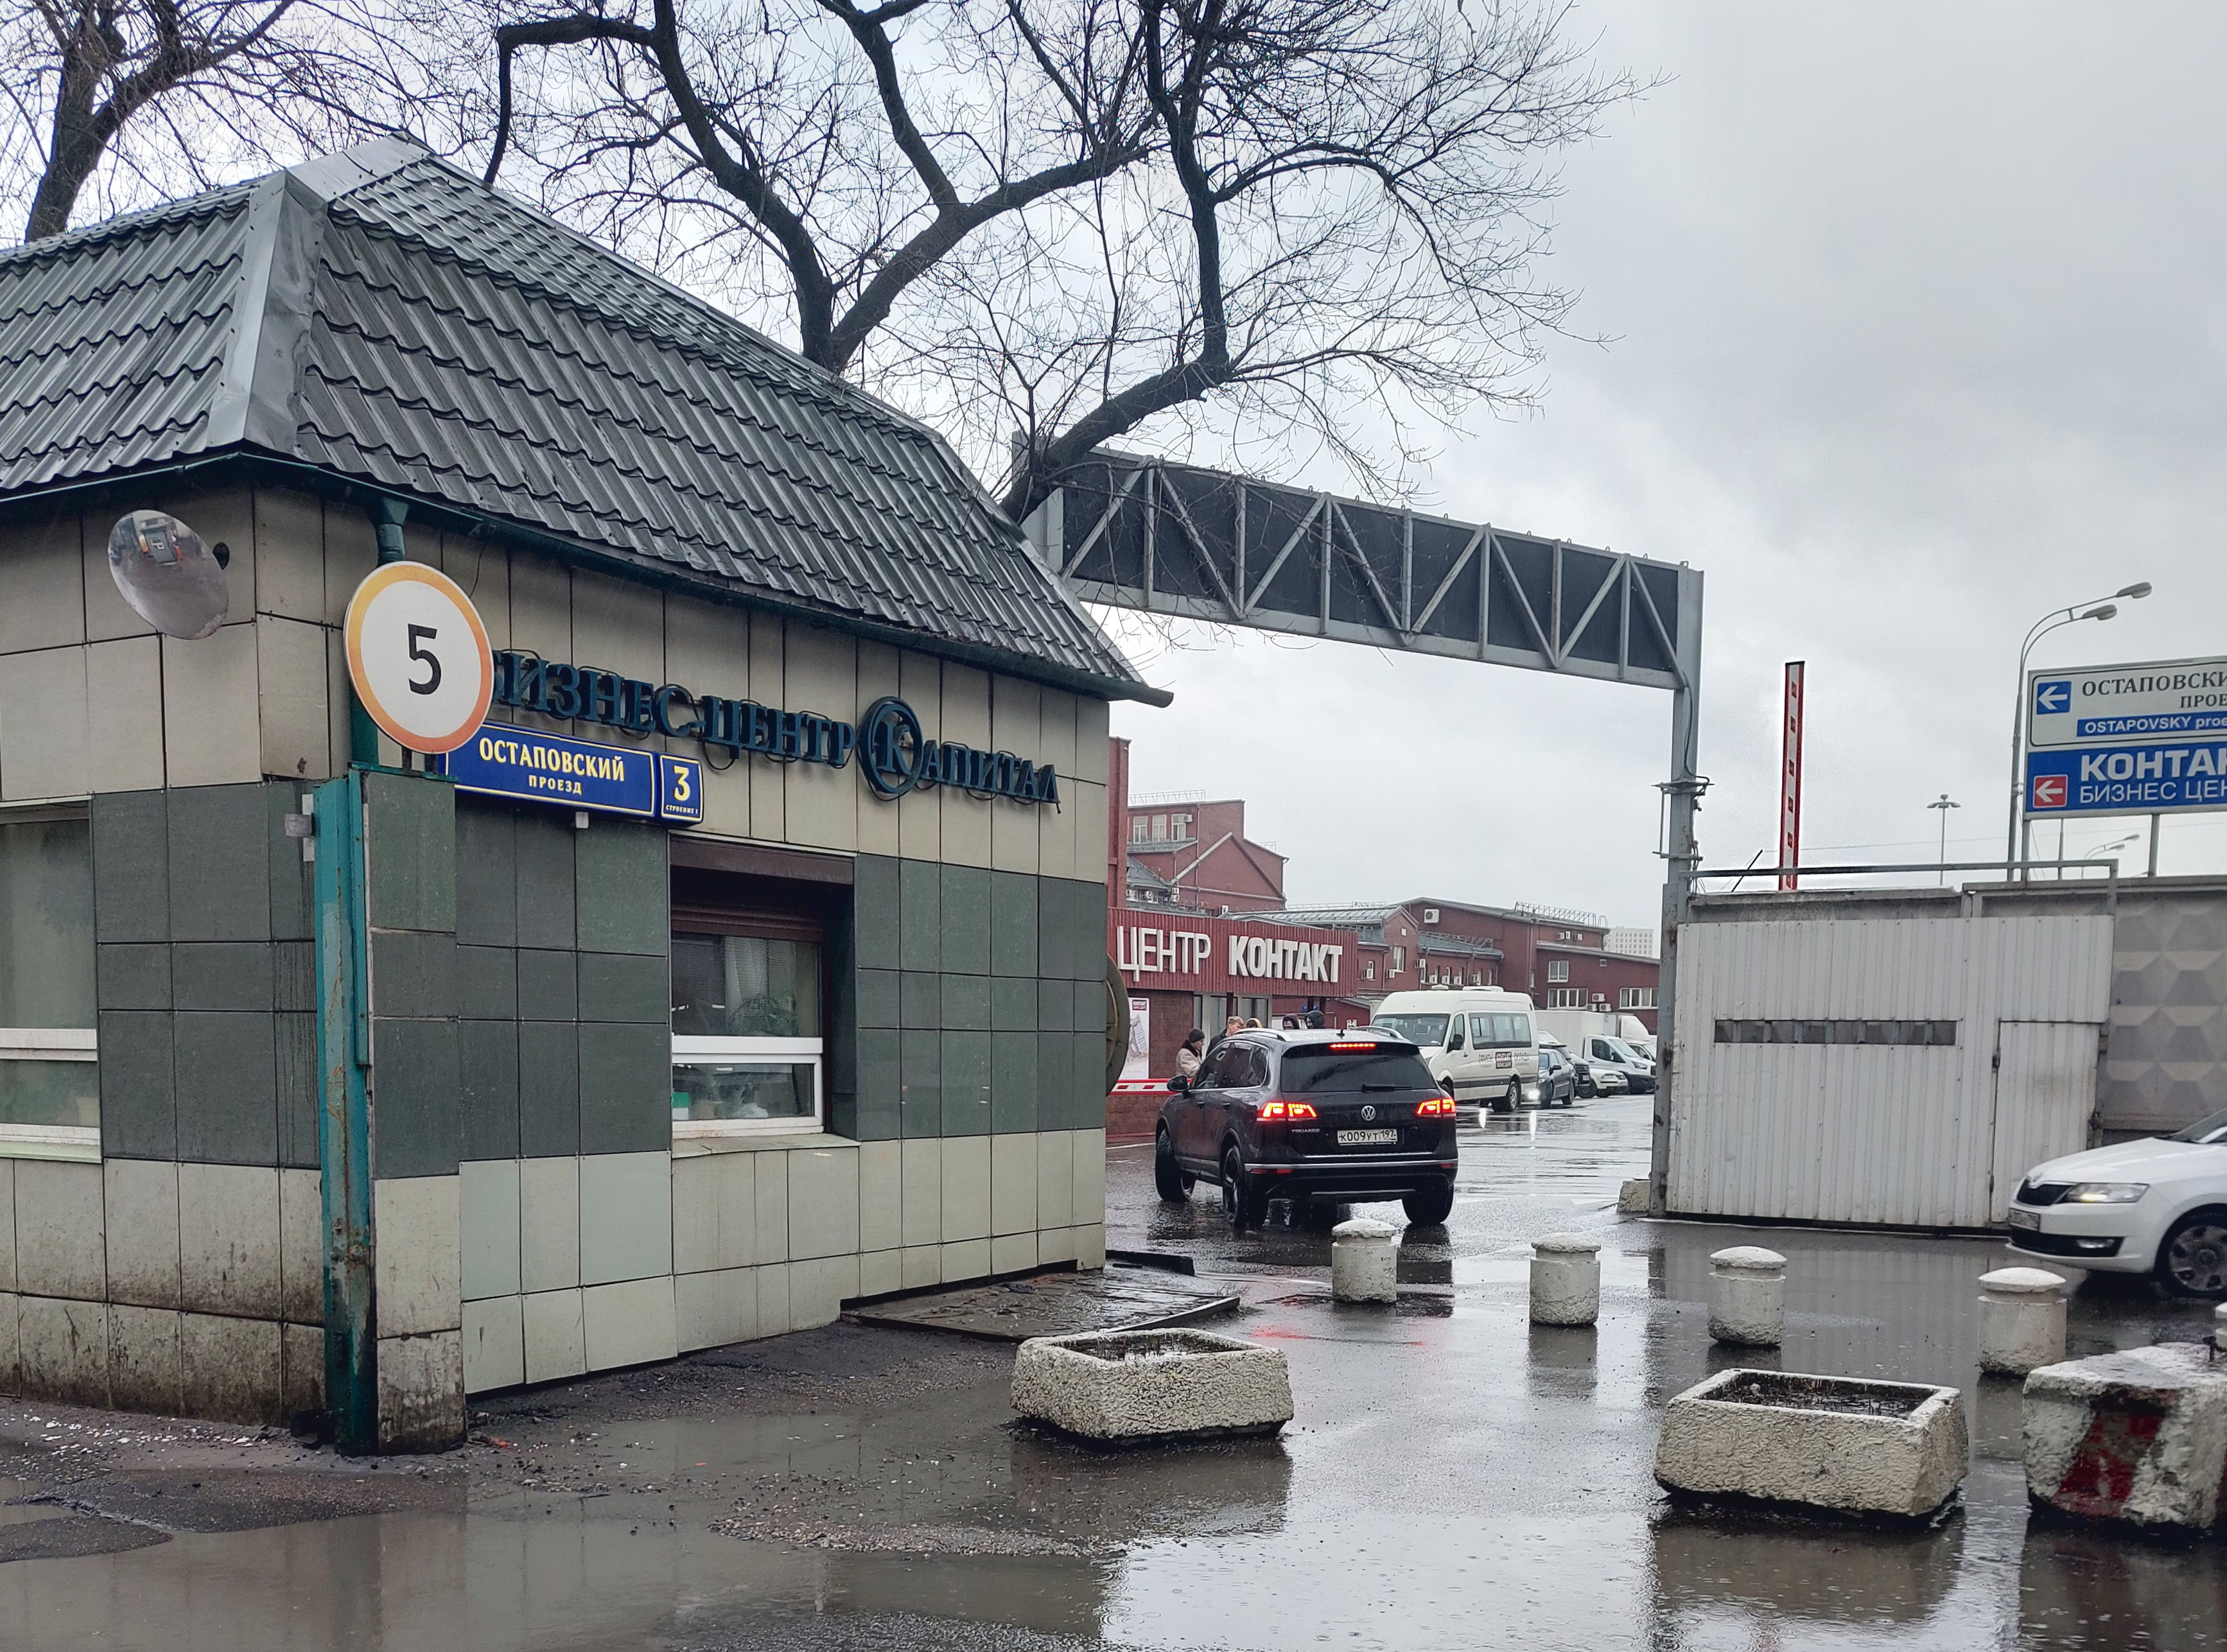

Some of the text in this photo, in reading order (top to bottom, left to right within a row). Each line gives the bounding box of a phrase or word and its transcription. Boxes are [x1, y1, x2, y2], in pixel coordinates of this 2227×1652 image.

[407, 623, 441, 695] 5
[2085, 716, 2191, 733] OSTAPOVSKY
[479, 738, 624, 781] ОСТАПОВСКИЙ
[528, 775, 582, 796] ПРОЕЗД
[674, 765, 690, 801] 3
[2080, 781, 2177, 803] БИЗНЕС
[665, 804, 694, 814] СТРОЕНИЕ
[1117, 926, 1343, 983] ЦЕНТР КОНТАКТ
